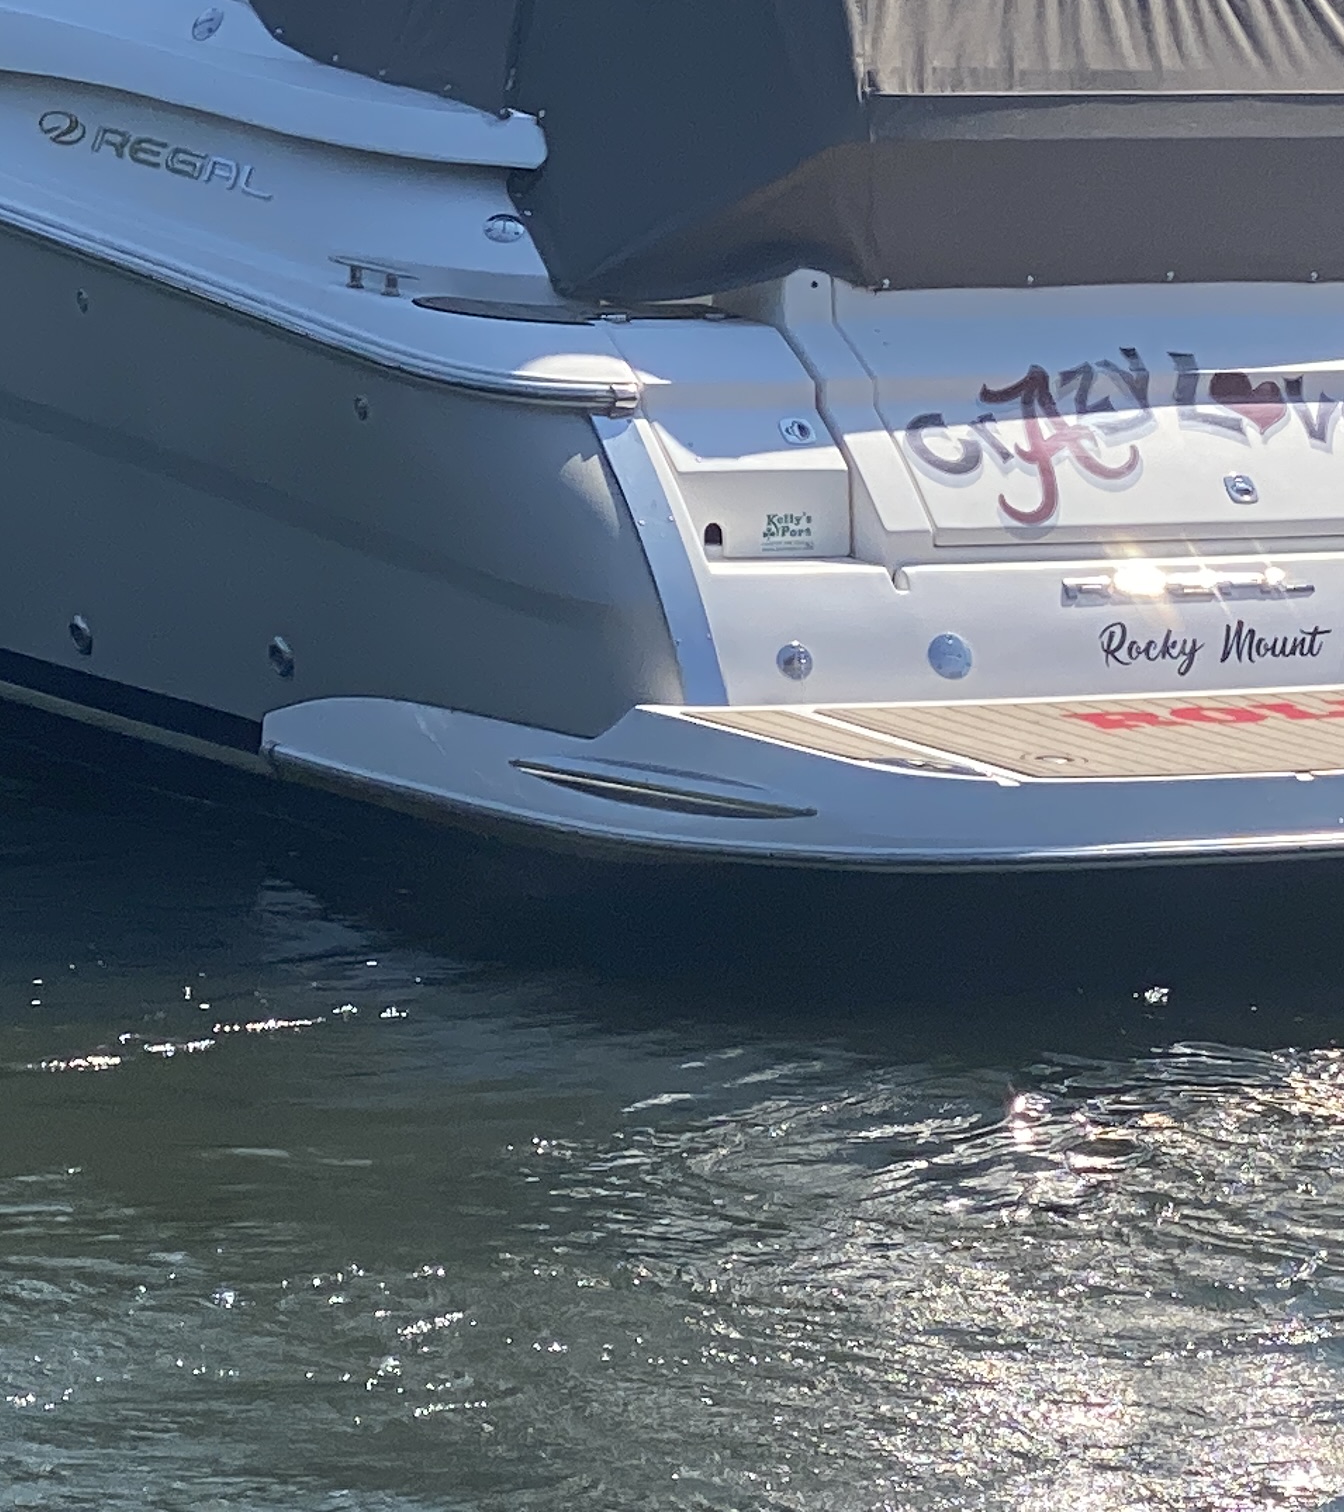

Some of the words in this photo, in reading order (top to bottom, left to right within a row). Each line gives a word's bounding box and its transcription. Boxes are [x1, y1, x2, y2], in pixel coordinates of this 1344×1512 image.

[91, 125, 273, 202] REGAL
[766, 511, 812, 527] Kelly's
[1099, 620, 1205, 677] Rocky
[1220, 618, 1333, 665] Mount
